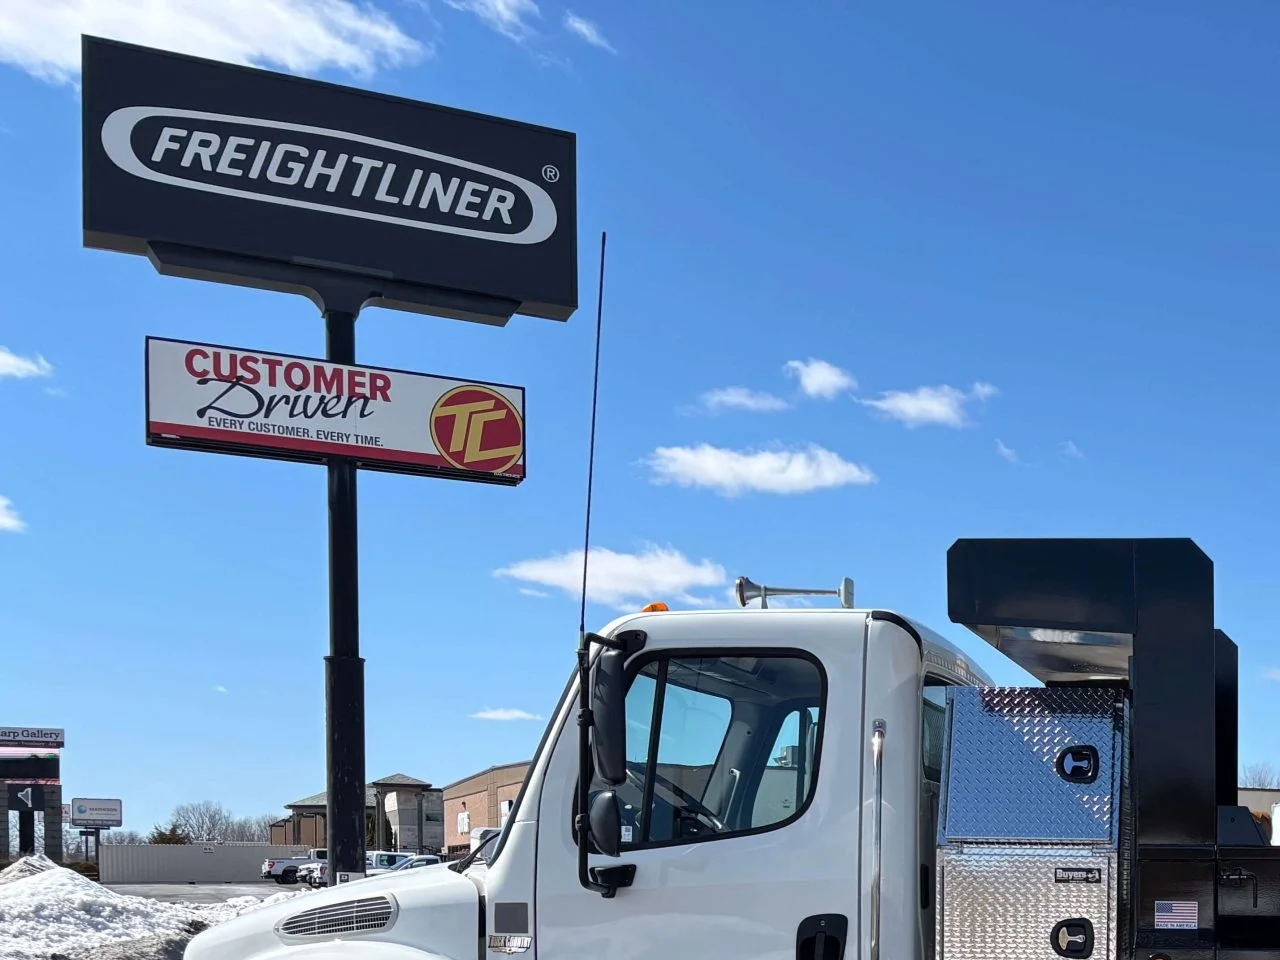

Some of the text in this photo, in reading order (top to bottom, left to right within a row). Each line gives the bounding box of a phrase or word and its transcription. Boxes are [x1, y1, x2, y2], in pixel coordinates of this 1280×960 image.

[151, 126, 516, 225] FREIGHTLINER
[184, 348, 392, 402] CUSTOMER
[196, 374, 375, 419] Driven
[208, 416, 384, 447] EVERY CUSTOMER. EVERY TIME.
[434, 399, 523, 464] TC
[21, 729, 60, 740] Gallery
[1056, 869, 1087, 880] Buyers
